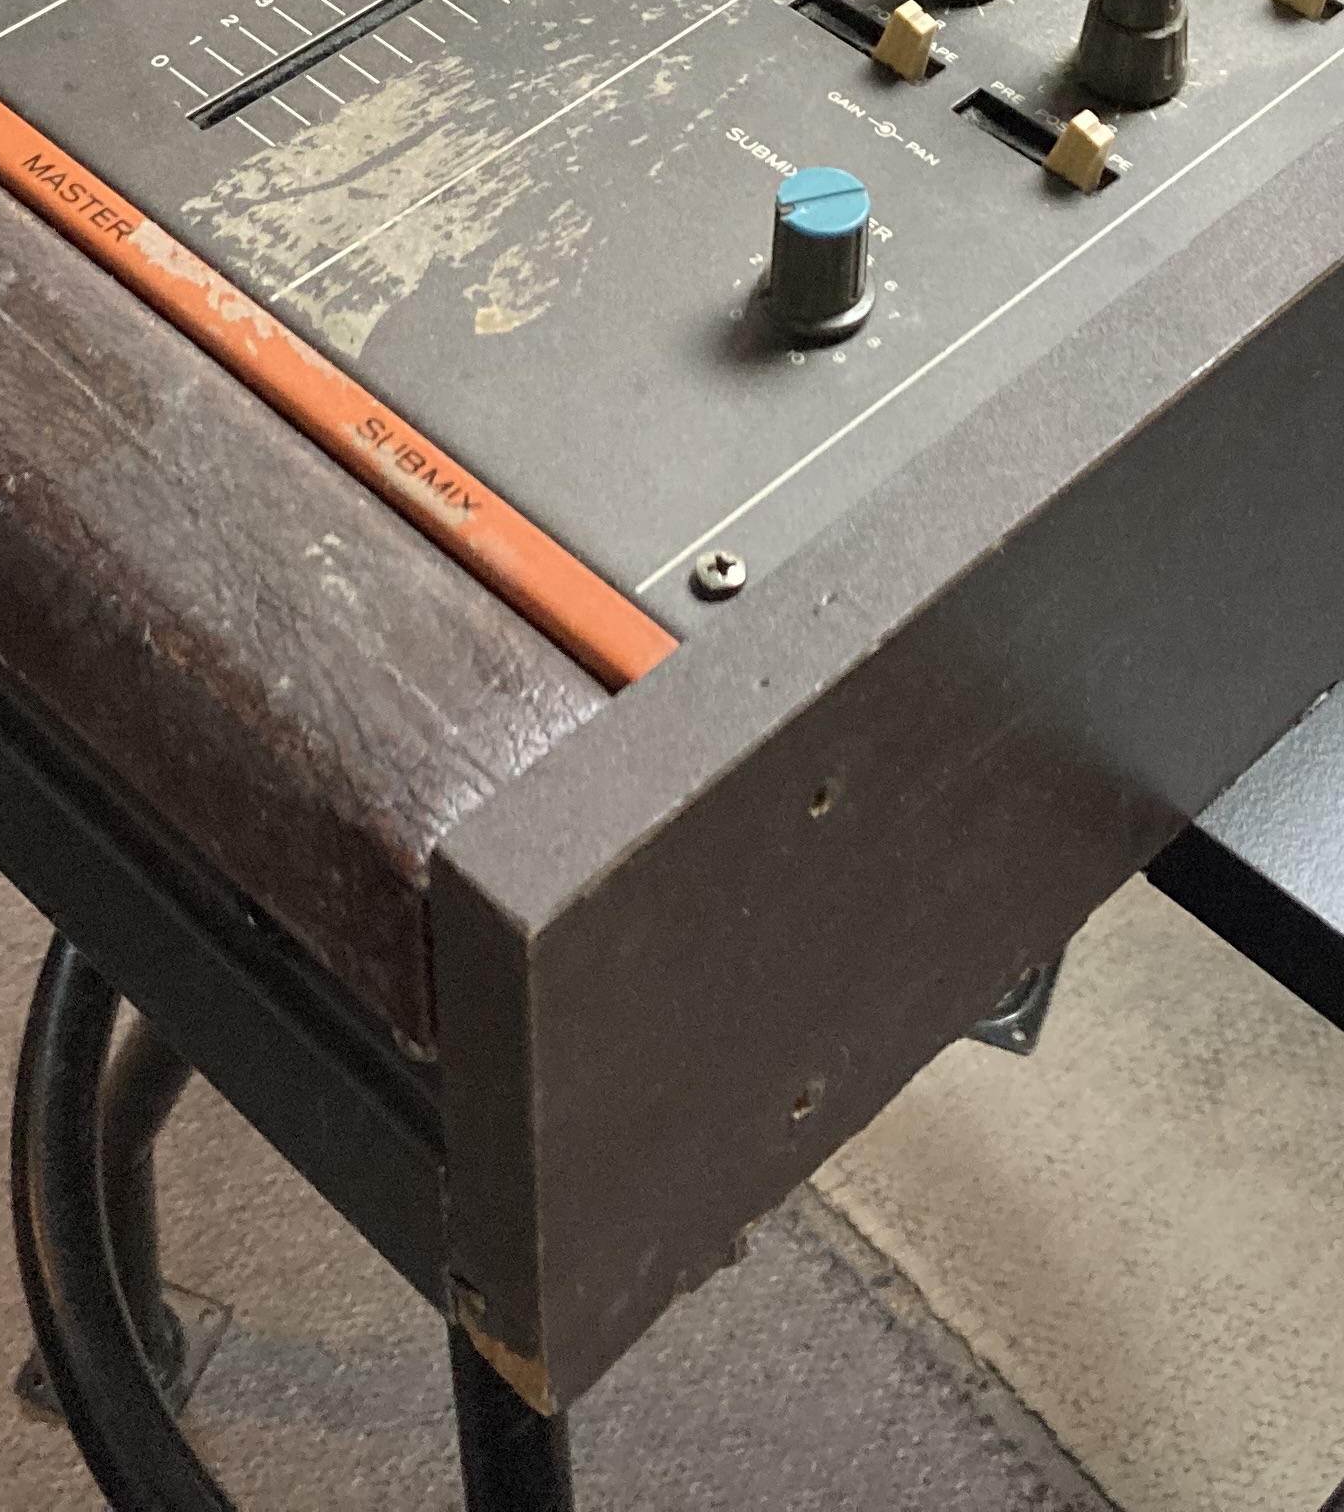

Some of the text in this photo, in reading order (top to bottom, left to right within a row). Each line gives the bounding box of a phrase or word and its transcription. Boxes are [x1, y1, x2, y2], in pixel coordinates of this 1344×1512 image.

[151, 54, 169, 68] 0
[189, 35, 202, 45] 1
[220, 14, 239, 27] 2
[928, 42, 959, 64] APE
[990, 81, 1026, 105] PRE
[827, 91, 941, 167] GAIN PAN
[1035, 109, 1069, 133] POS
[22, 152, 135, 243] MASTER
[357, 417, 482, 512] SUBMIX
